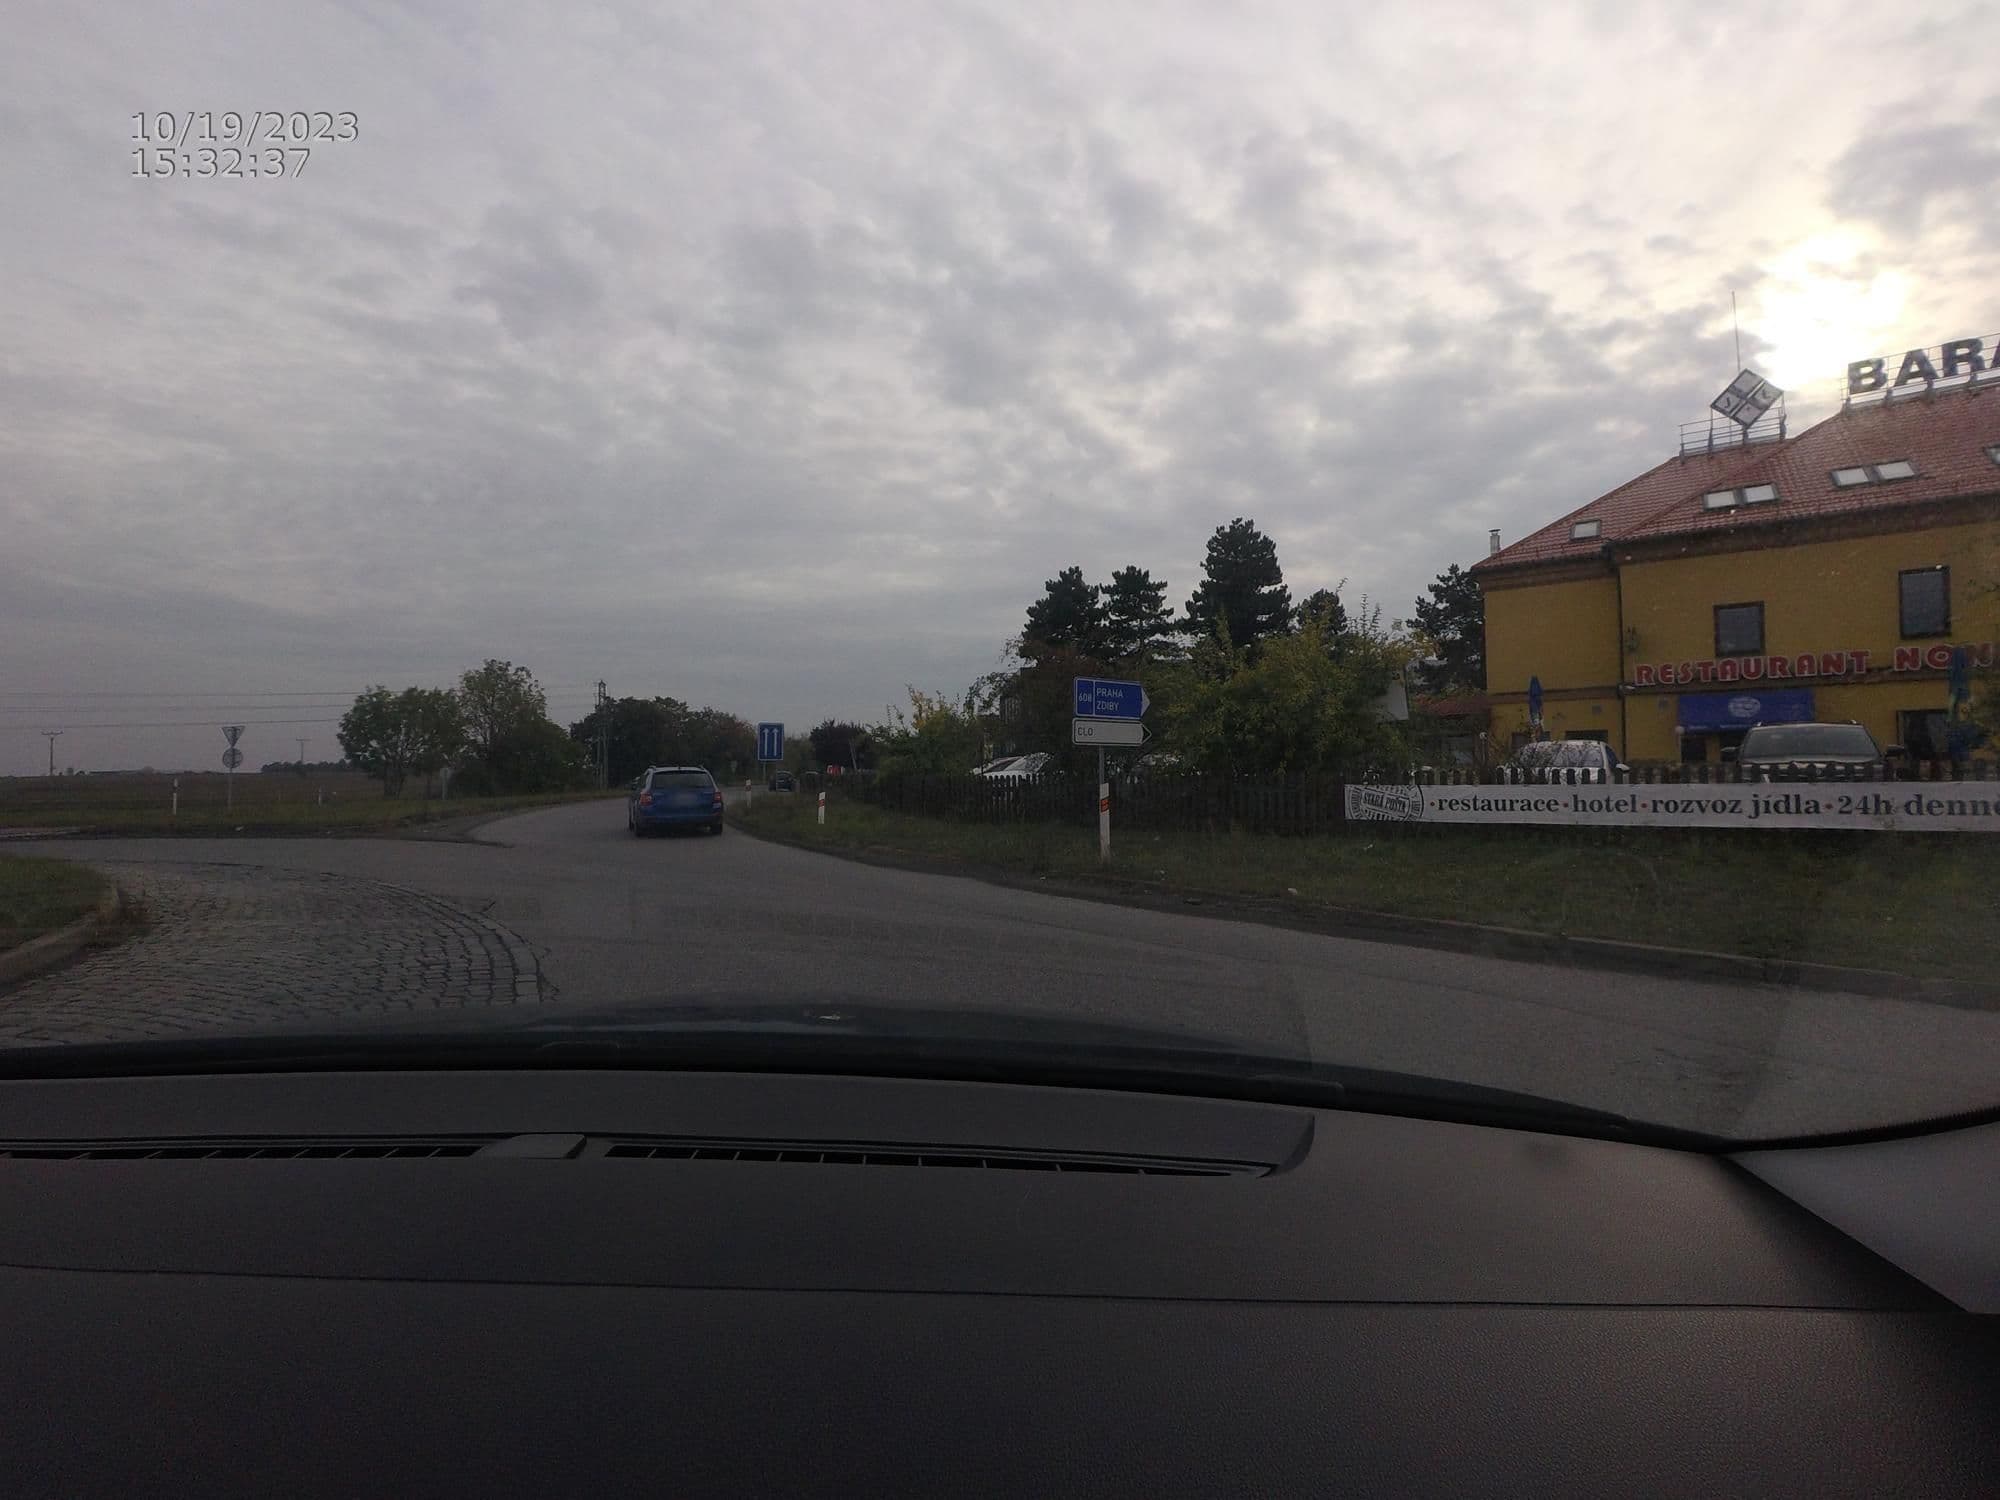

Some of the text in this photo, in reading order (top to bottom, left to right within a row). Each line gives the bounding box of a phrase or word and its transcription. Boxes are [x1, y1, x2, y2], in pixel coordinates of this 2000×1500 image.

[1634, 650, 1870, 687] RESTAURANT
[1096, 687, 1124, 698] PRAHA
[1096, 701, 1120, 711] ZDIBY
[1077, 727, 1094, 737] CLO
[1438, 797, 1559, 813] restaurace
[1573, 794, 1637, 813] hotel
[1651, 798, 1742, 814] rozvoz
[1748, 794, 1821, 819] jídla
[1837, 793, 1892, 815] 24h
